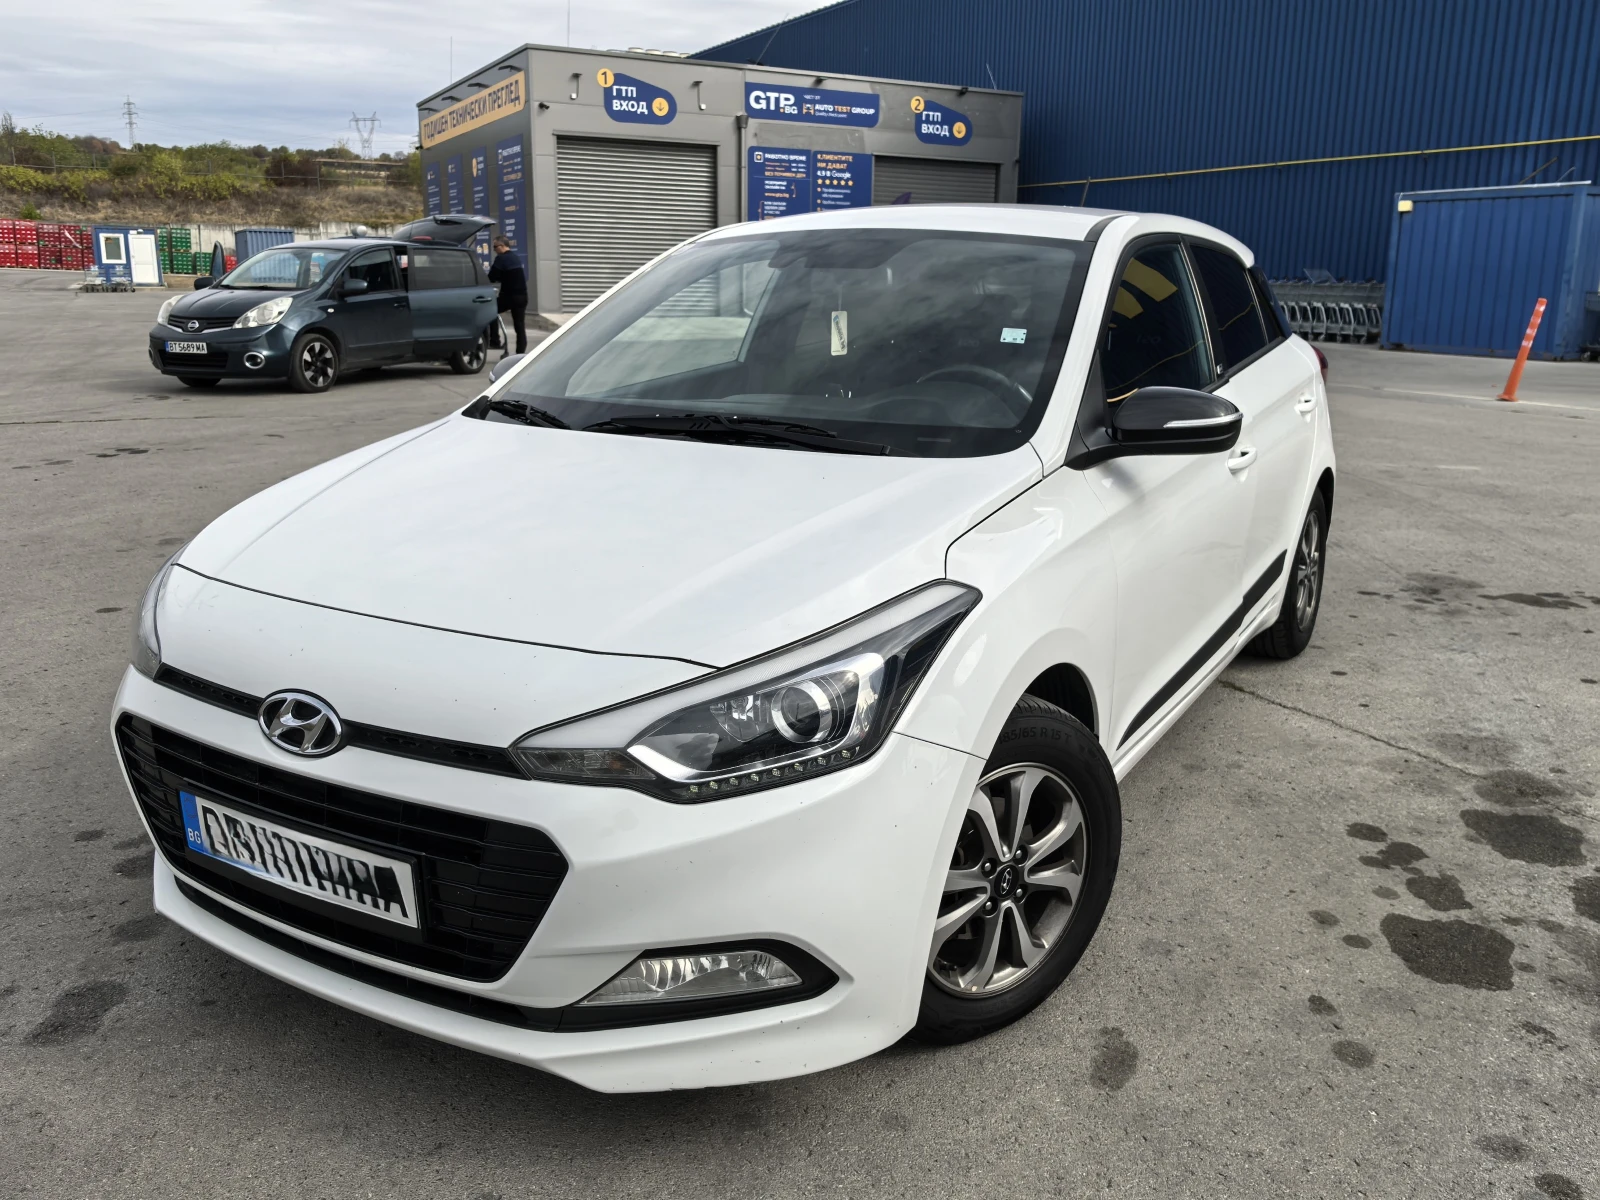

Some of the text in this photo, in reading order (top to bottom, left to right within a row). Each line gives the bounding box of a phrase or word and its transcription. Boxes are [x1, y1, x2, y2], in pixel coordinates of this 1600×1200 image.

[601, 71, 608, 85] 1
[487, 79, 521, 113] ПРЕГЛЕД
[612, 86, 637, 98] ГТП
[612, 100, 649, 115] ВХОД
[815, 103, 834, 112] AUTO
[834, 105, 851, 113] TEST
[851, 106, 876, 116] GROUP
[914, 98, 922, 111] 2
[922, 111, 942, 123] ГТП
[921, 123, 950, 138] ВХОД
[817, 153, 853, 162] КЛИЕНТИТЕ
[827, 162, 848, 170] ДАВАТ
[832, 170, 852, 180] Google
[178, 342, 195, 352] 5689
[1040, 726, 1048, 738] R
[1050, 727, 1062, 741] 15
[188, 827, 202, 844] BG
